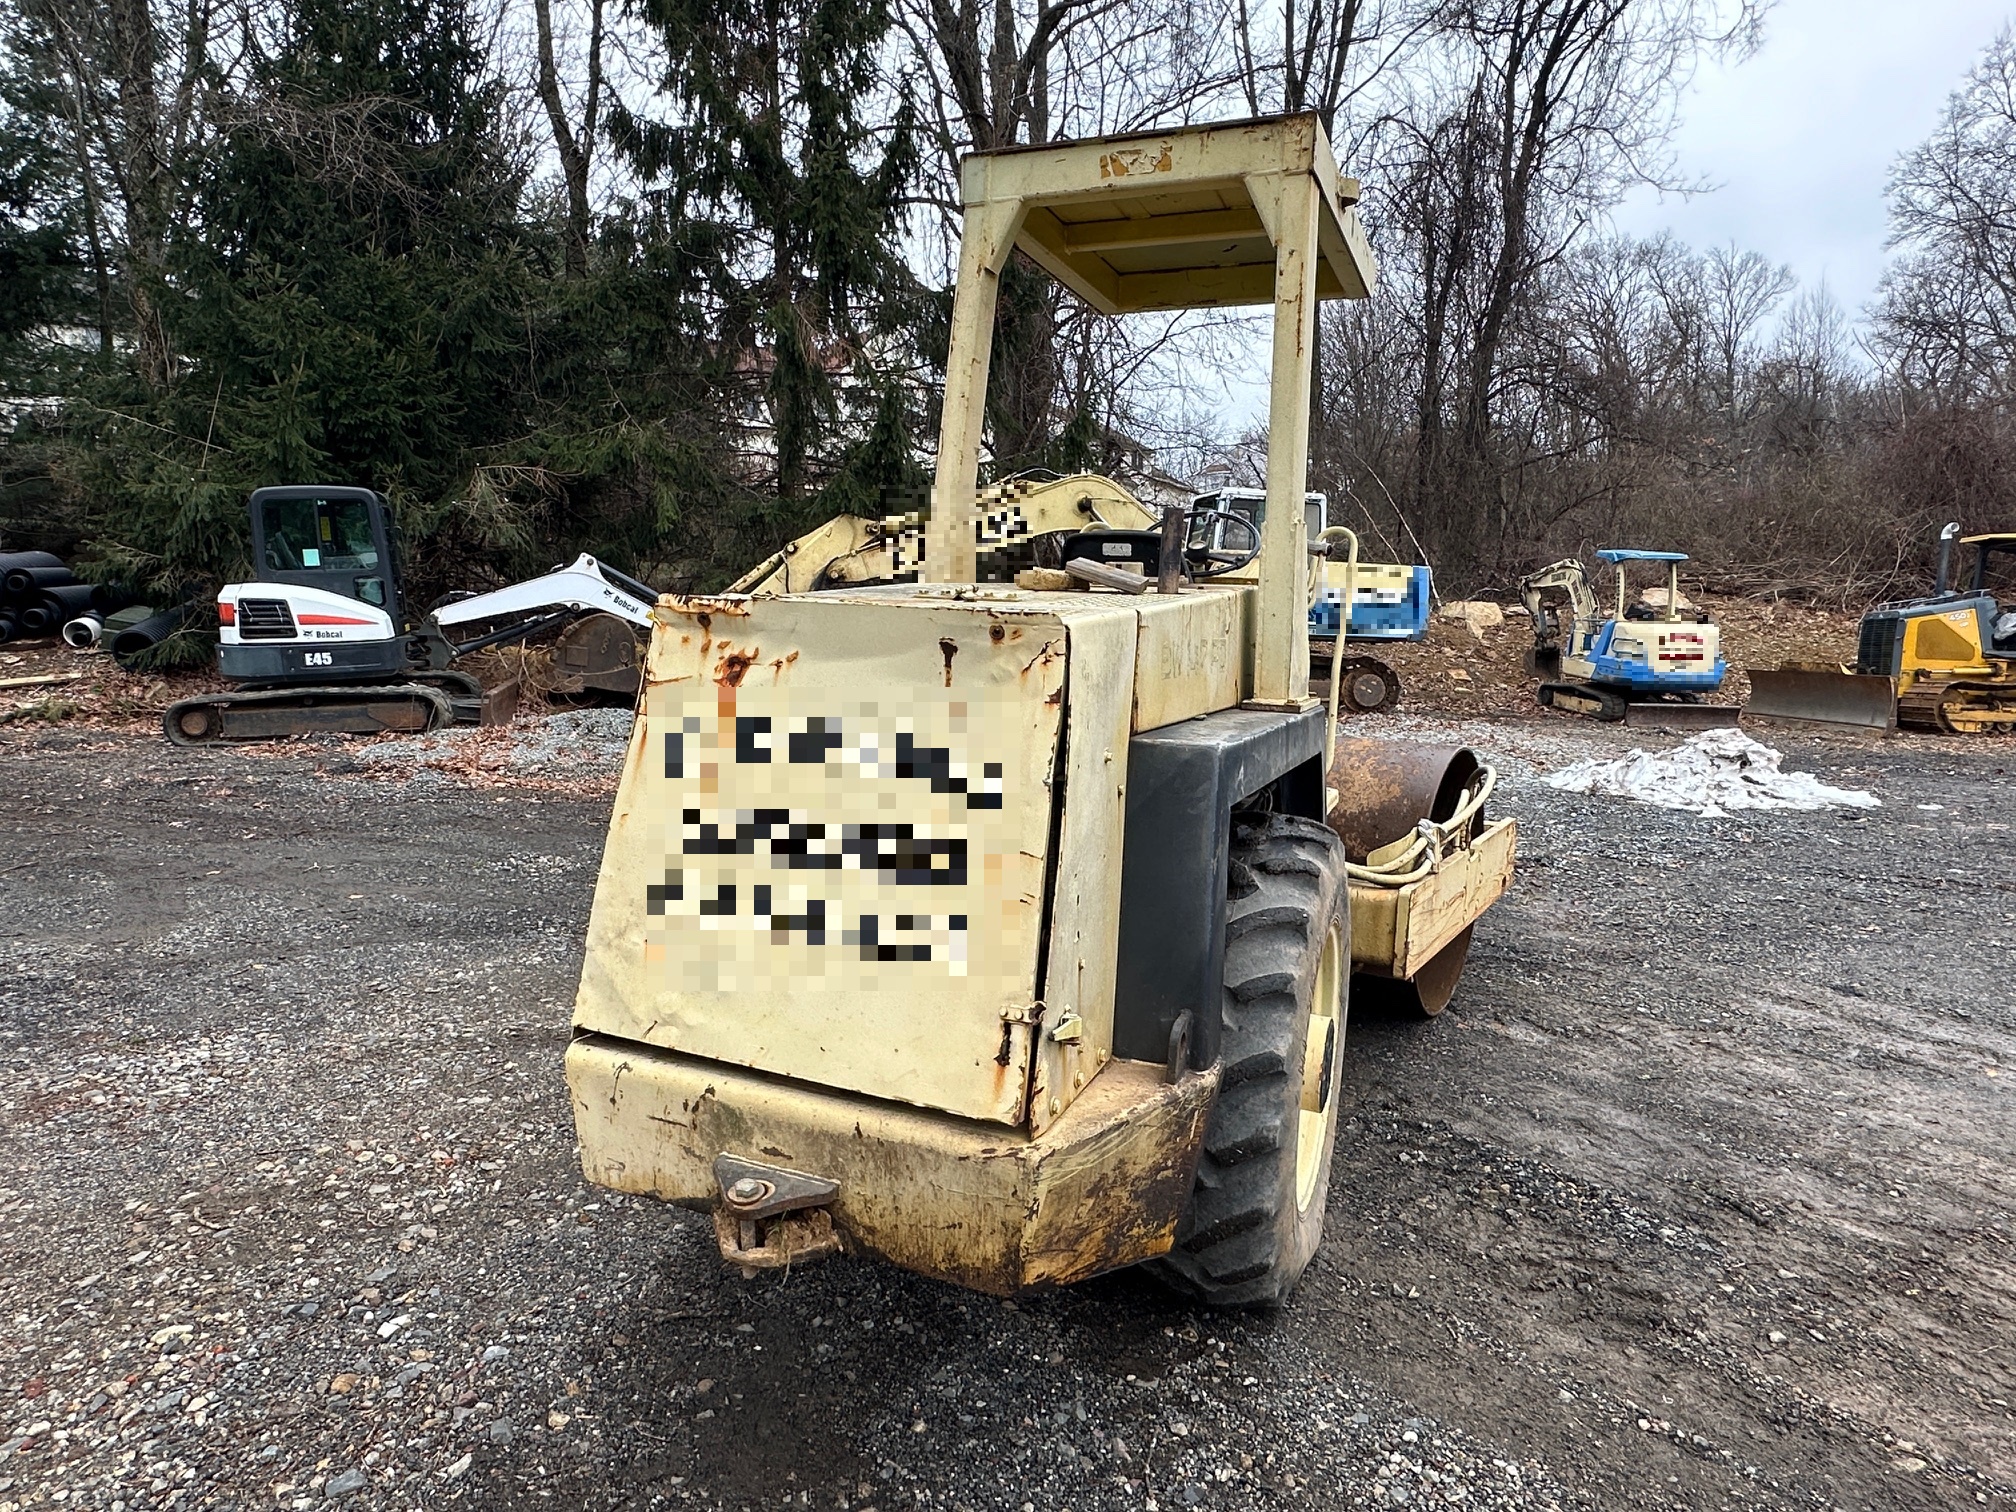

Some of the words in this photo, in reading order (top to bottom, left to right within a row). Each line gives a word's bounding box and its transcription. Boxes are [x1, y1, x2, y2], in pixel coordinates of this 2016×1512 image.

[613, 595, 639, 615] Bobcat
[316, 630, 343, 638] Bobcat
[304, 652, 333, 666] E45
